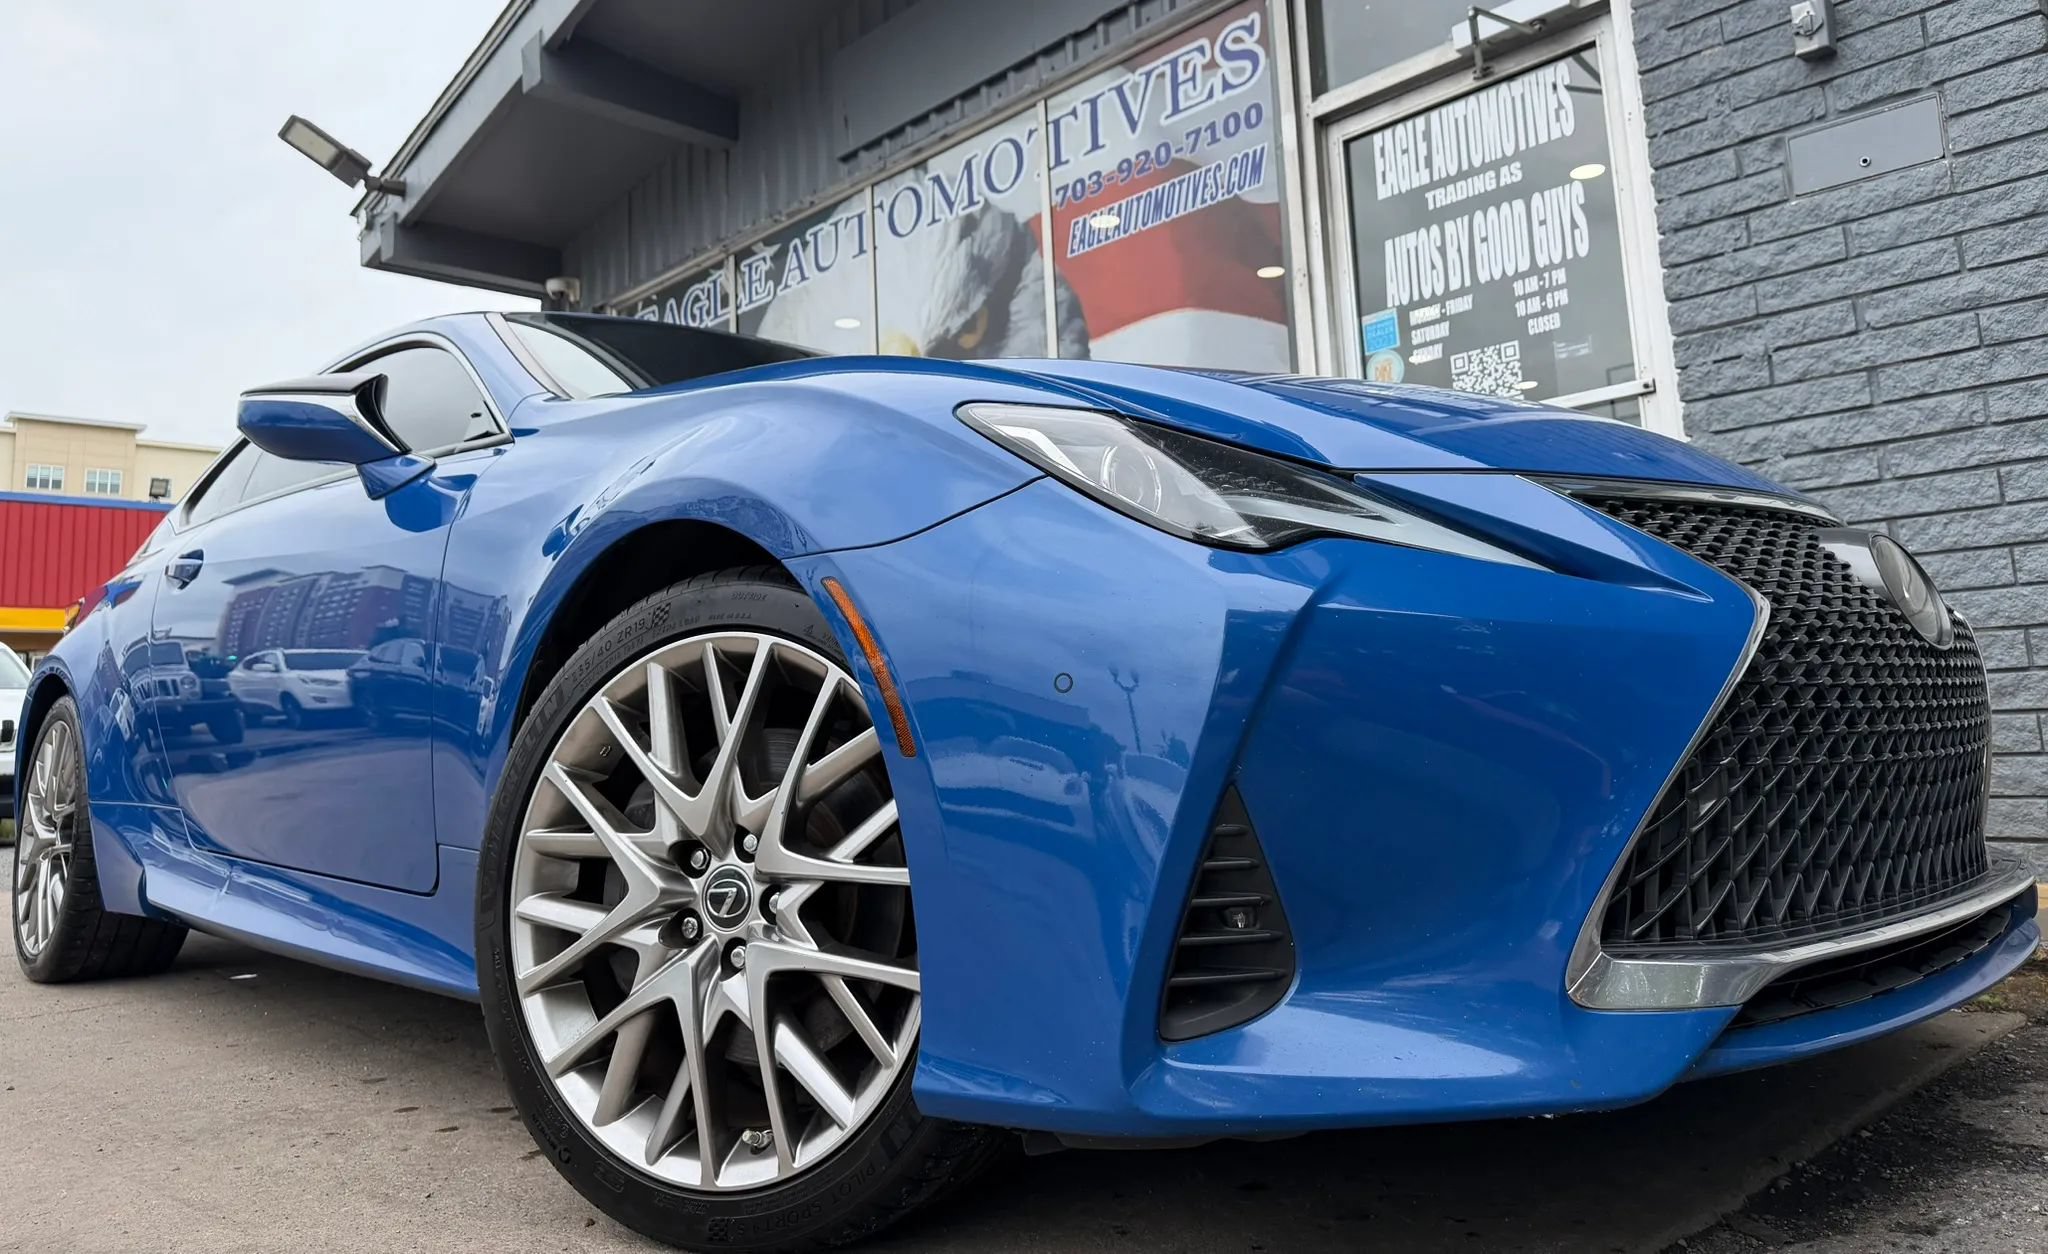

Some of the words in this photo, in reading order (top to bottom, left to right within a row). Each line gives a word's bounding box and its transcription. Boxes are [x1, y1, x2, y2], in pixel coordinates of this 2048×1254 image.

[1372, 118, 1430, 201] EAGLE
[1430, 62, 1576, 179] AUTOMOTIVES
[777, 12, 1266, 293] AUTOMOTIVES
[1055, 101, 1265, 209] 703-920-7100
[1067, 143, 1268, 258] EAGLEAUTOMOTIVES.COM
[1425, 170, 1497, 211] TRADING
[1500, 160, 1523, 187] AS
[1384, 223, 1445, 308] AUTOS
[1445, 214, 1473, 292] BY
[1473, 199, 1532, 284] GOOD
[1531, 180, 1590, 268] GUYS
[1513, 280, 1526, 297] 10
[1525, 275, 1539, 294] AM
[1543, 272, 1550, 289] 7
[1551, 267, 1567, 286] PM
[1446, 294, 1473, 316] FRIDAY
[1515, 300, 1526, 318] 10
[1526, 296, 1541, 315] AM
[1553, 288, 1569, 307] PM
[1411, 320, 1450, 345] SATURDAY
[1527, 312, 1561, 335] CLOSED
[616, 617, 645, 644] ZR19
[831, 1161, 877, 1199] PILOT
[763, 1202, 823, 1233] SPORT
